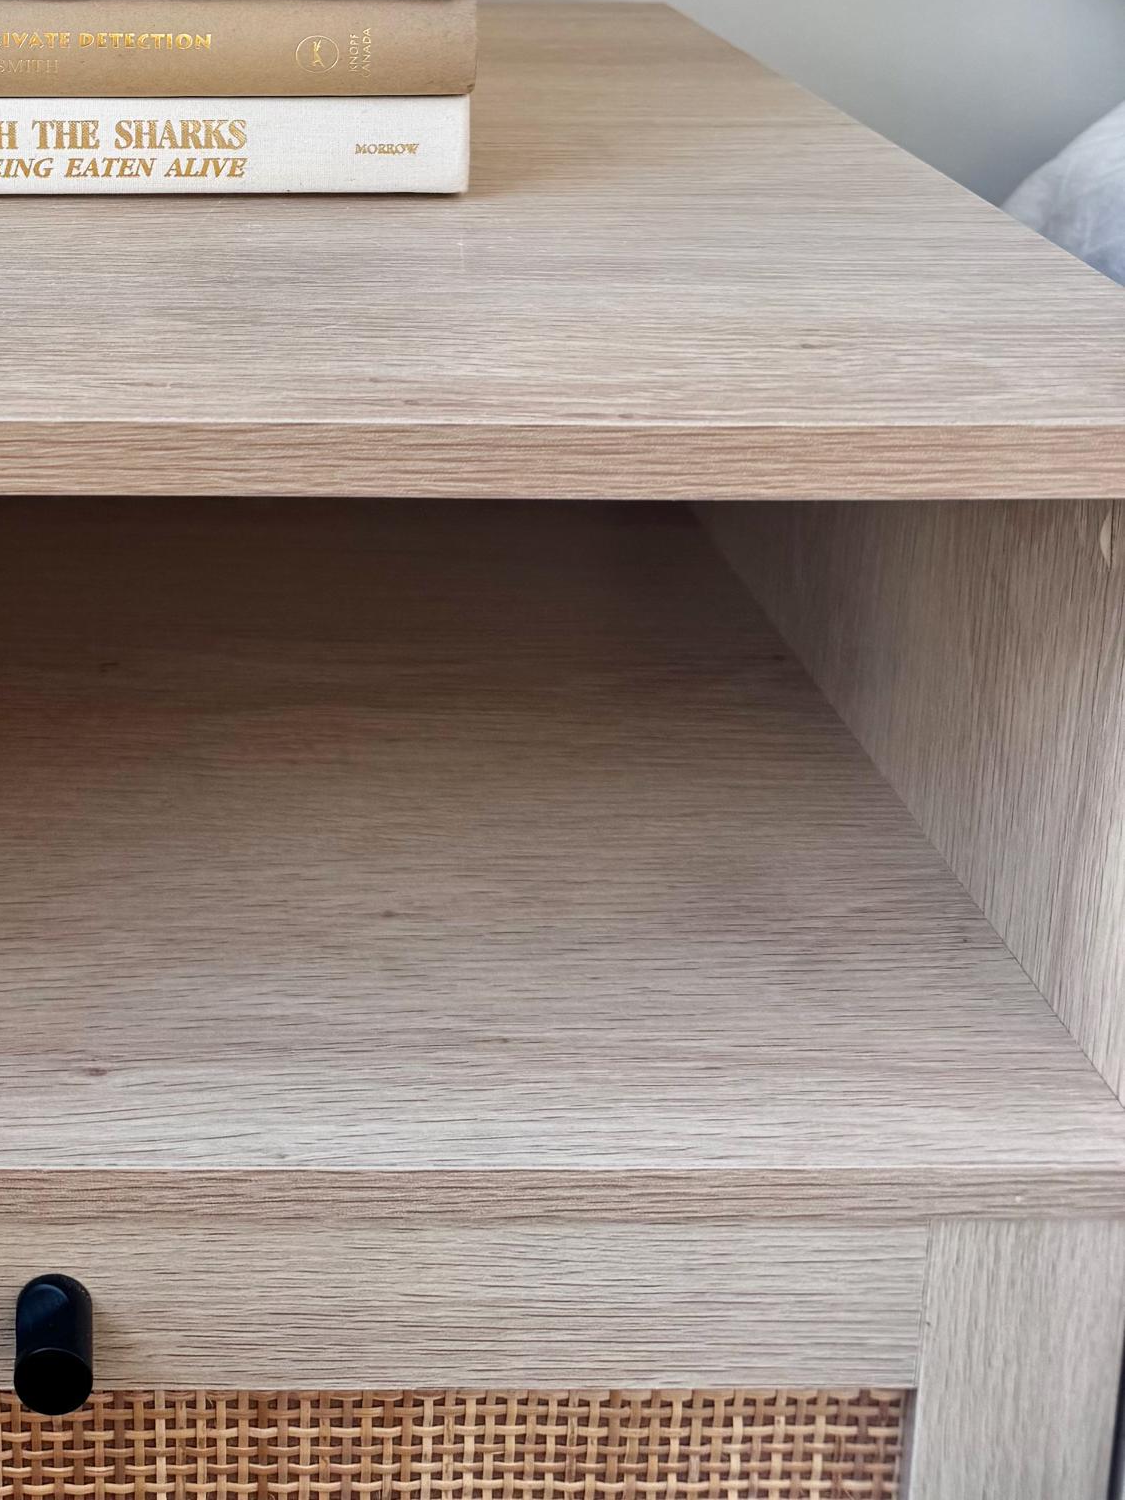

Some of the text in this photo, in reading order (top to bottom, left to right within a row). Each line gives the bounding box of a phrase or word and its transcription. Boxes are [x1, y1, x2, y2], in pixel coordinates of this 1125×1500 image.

[80, 31, 212, 50] DETECTION
[349, 33, 359, 72] KNOPF
[32, 120, 100, 150] THE
[114, 120, 246, 150] SHARKS
[355, 143, 420, 155] MORROW
[64, 158, 156, 178] EATEN
[164, 158, 247, 178] ALIVE
